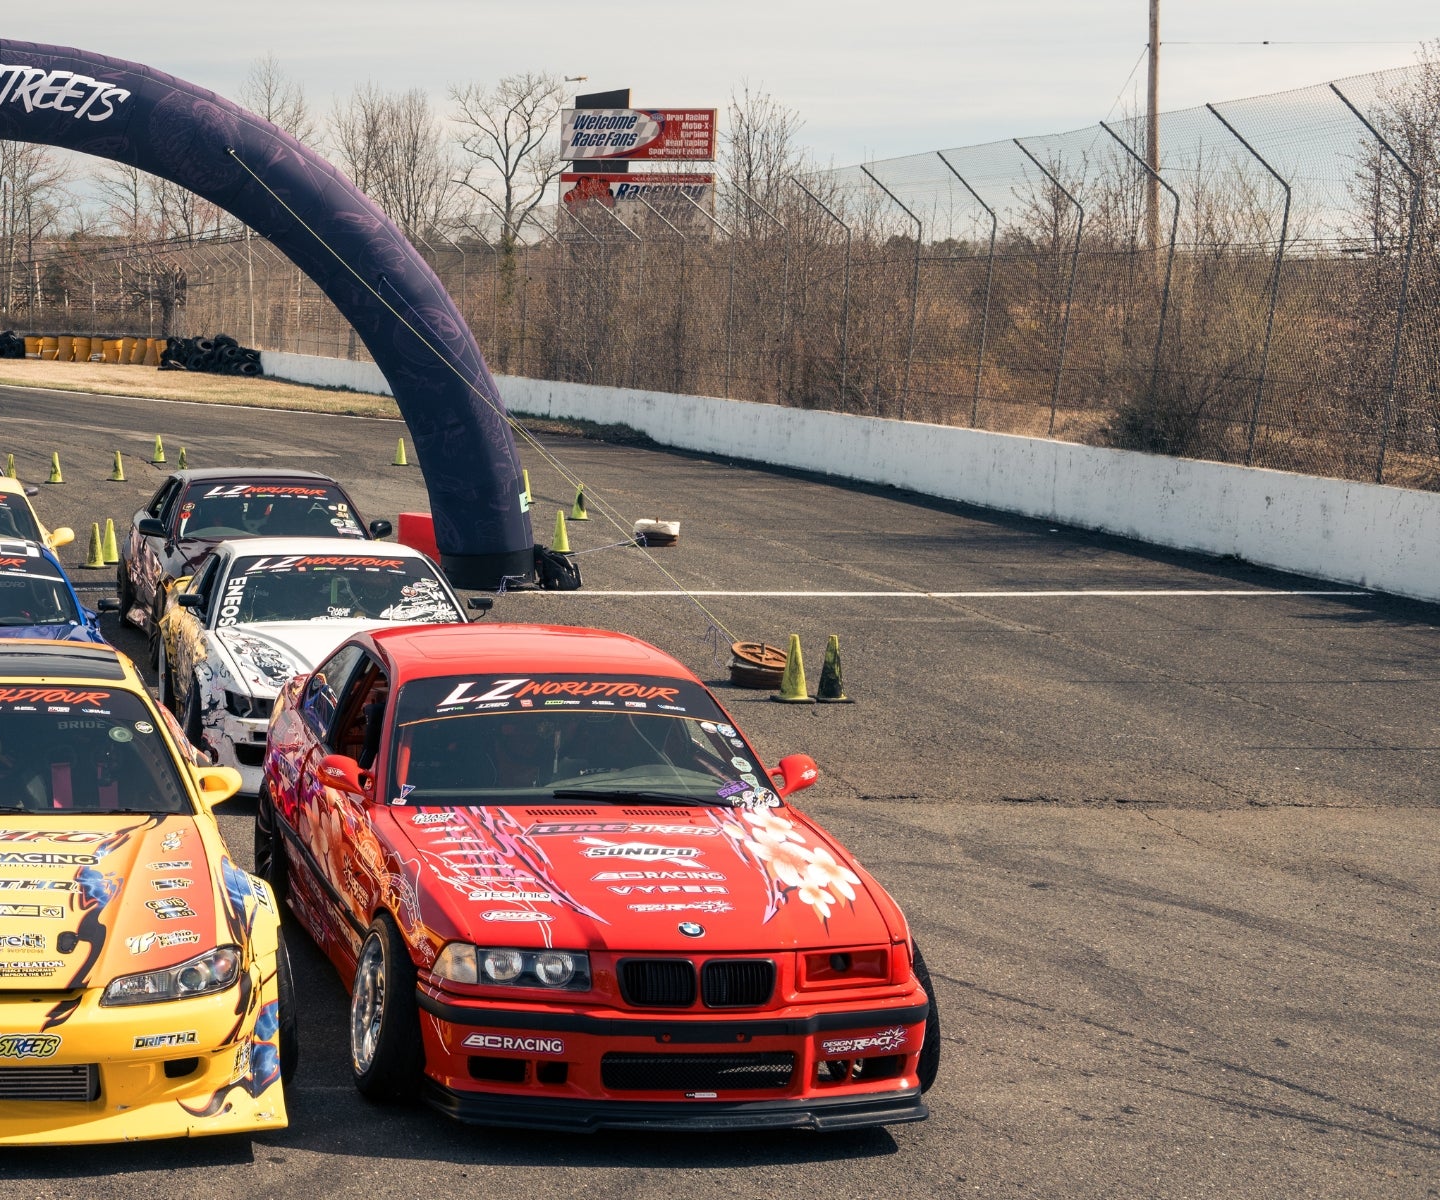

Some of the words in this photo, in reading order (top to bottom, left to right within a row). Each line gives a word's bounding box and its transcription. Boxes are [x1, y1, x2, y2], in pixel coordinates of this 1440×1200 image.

[573, 114, 638, 131] Welcome
[685, 113, 709, 121] Racing
[681, 122, 709, 130] Moto-X
[205, 485, 252, 496] LZ
[244, 486, 328, 497] WORLDTOUR
[245, 556, 305, 572] LZ
[296, 556, 405, 569] WORLDTOUR
[217, 576, 248, 627] ENEOS
[436, 678, 531, 707] LZ
[513, 680, 680, 703] WORLDTOUR
[57, 719, 106, 730] BRIDE
[535, 824, 625, 833] TIRE
[627, 823, 721, 836] STREETS
[591, 847, 693, 857] SUNOCO
[610, 885, 728, 895] VYPER
[160, 934, 200, 946] Factory
[134, 1031, 197, 1049] DRIFTHQ
[822, 1039, 854, 1048] DESIGN
[851, 1036, 893, 1051] REACT
[827, 1044, 852, 1053] SHOP
